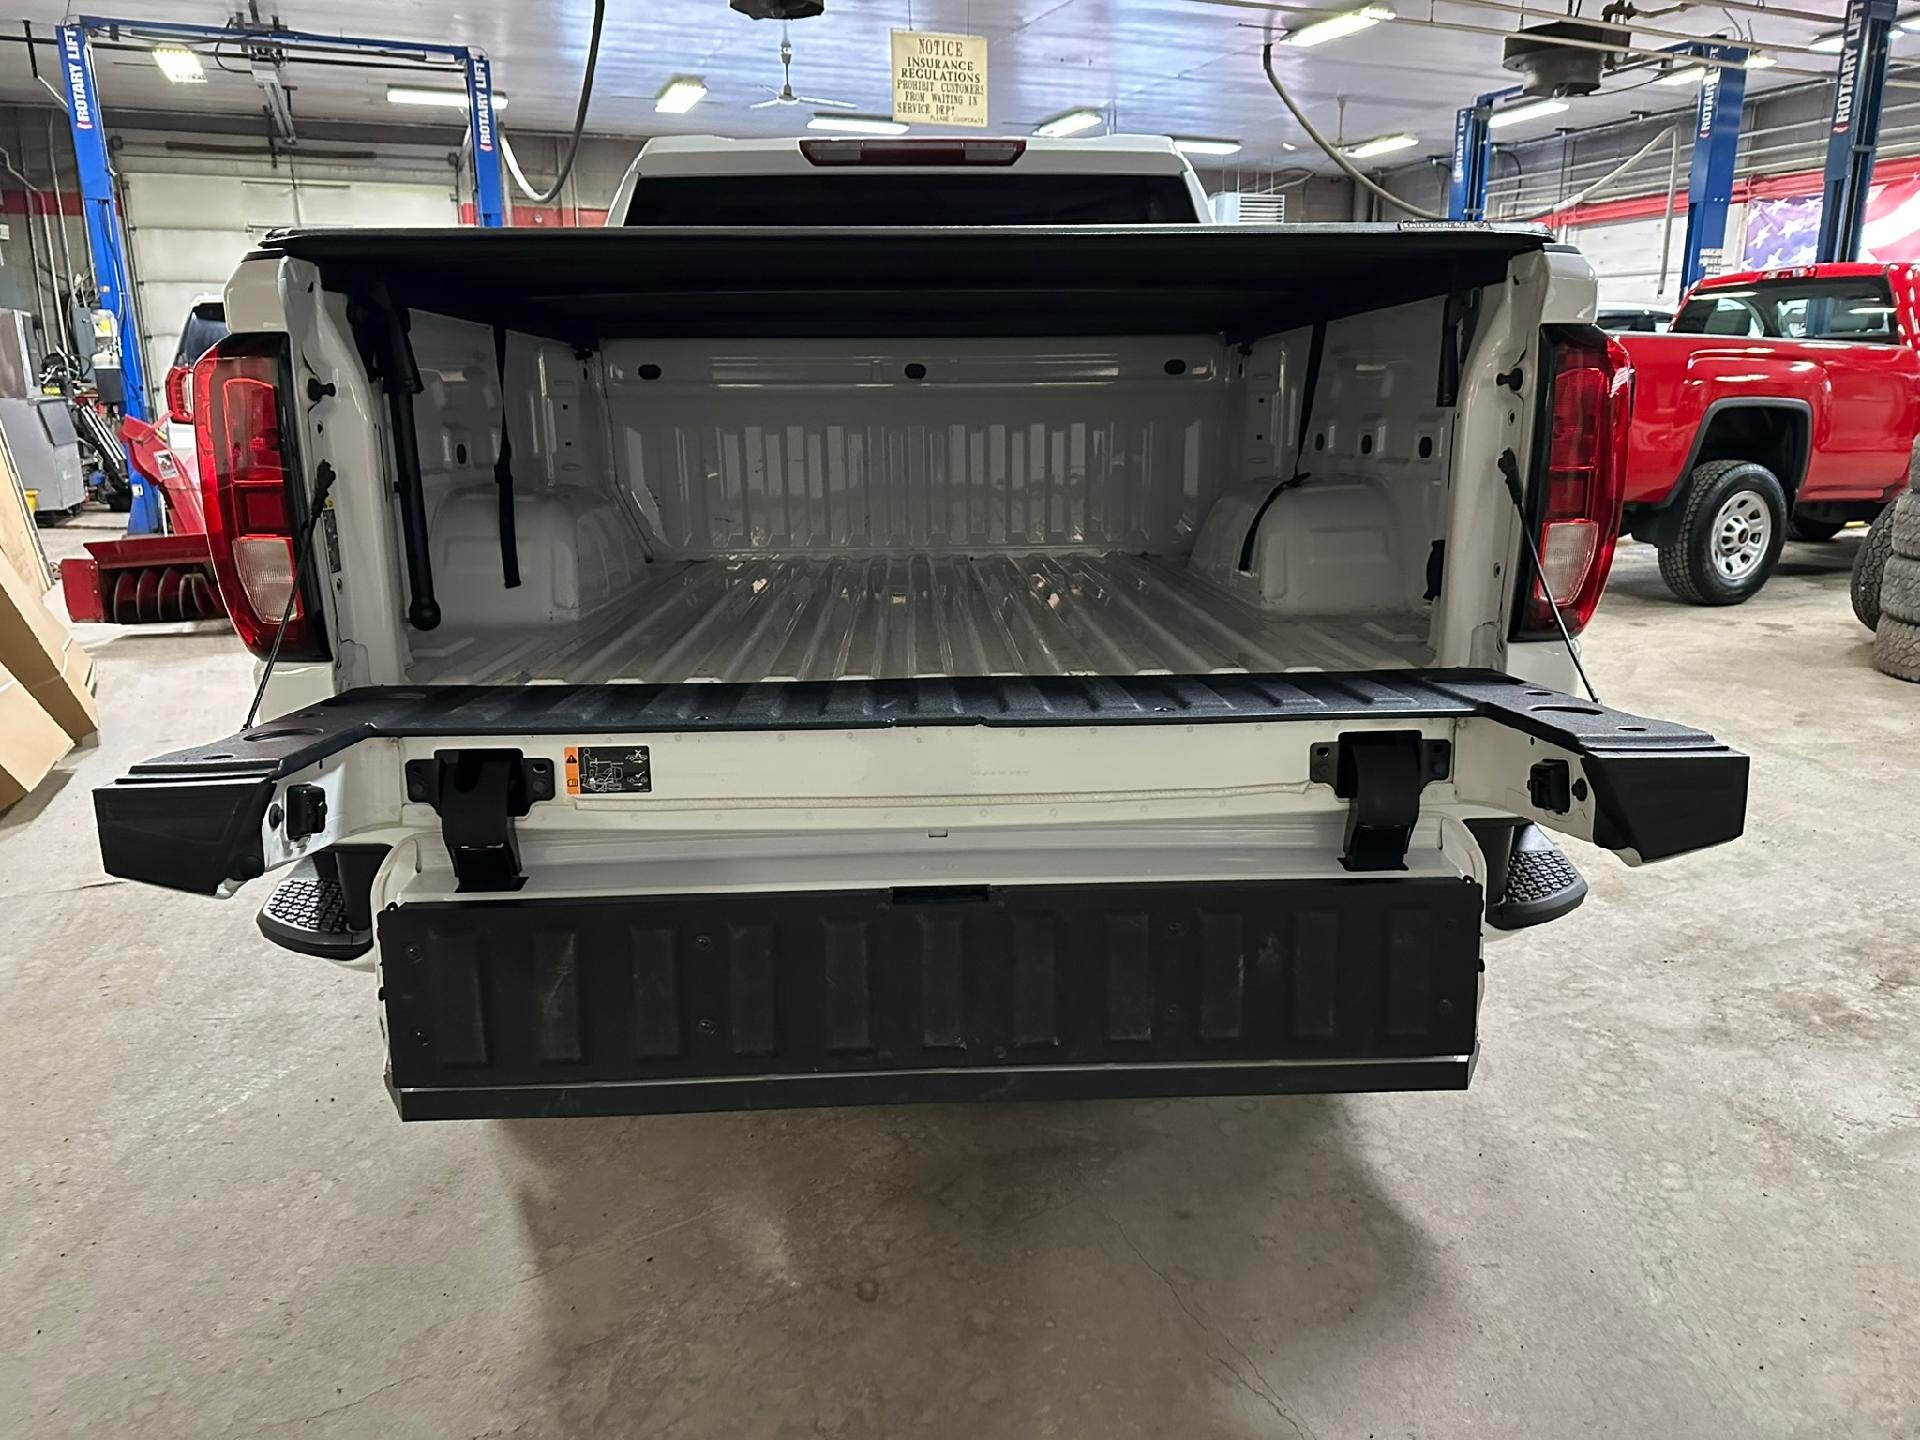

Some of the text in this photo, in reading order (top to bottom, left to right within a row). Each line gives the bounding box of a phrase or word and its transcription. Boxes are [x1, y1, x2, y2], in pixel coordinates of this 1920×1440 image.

[919, 38, 963, 57] NOTICE
[907, 56, 974, 71] INSURANCE
[1835, 1, 1865, 123] ROTARY LIFT
[64, 27, 90, 122] ROTARY LIFT
[901, 67, 981, 83] REGULATIONS
[897, 79, 934, 92] PROHIBIT
[474, 60, 491, 144] ROTARY LIFT
[905, 91, 977, 106] FROM WAITING IN
[897, 102, 930, 114] SERVICE
[1454, 110, 1466, 177] ROTARY LIFT
